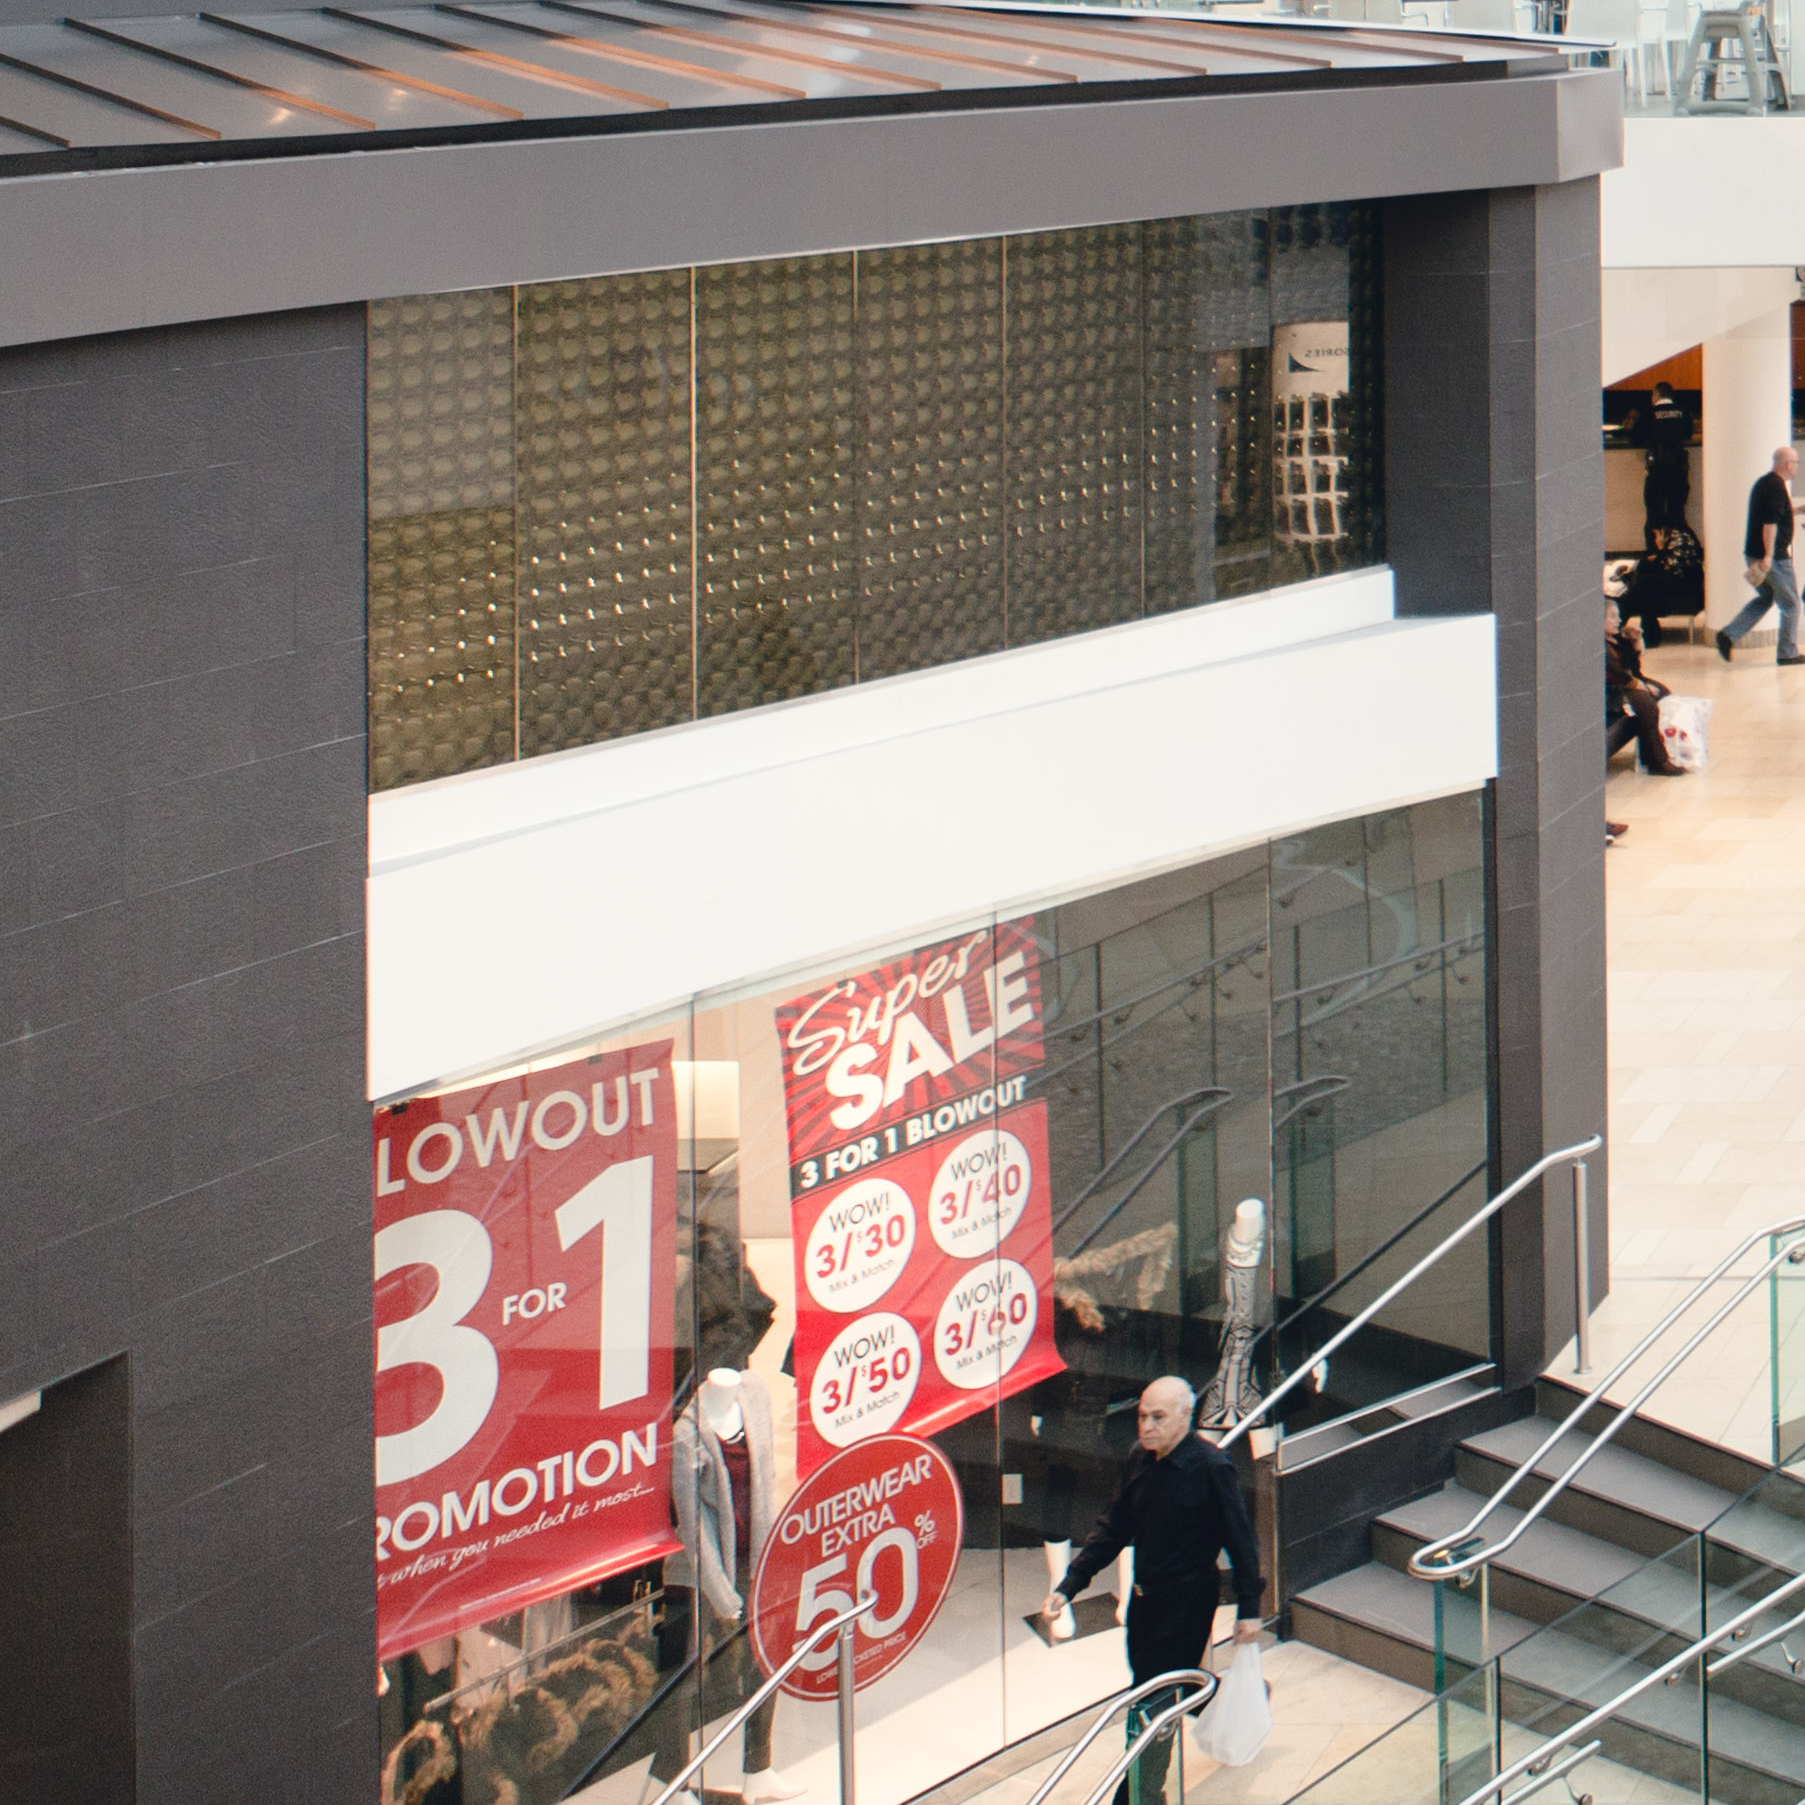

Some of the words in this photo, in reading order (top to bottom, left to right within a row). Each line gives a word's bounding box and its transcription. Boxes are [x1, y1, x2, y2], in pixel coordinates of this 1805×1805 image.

[787, 929, 989, 1076] Super
[825, 951, 1035, 1130] SALE
[800, 1160, 818, 1189] 3
[824, 1136, 879, 1180] FOR
[884, 1127, 898, 1154] 1
[906, 1075, 1028, 1146] BLOWOUT
[951, 1142, 1008, 1181] WOW!
[829, 1191, 890, 1233] WOW!
[951, 1225, 971, 1240] Mix
[980, 1206, 1012, 1228] Match
[502, 1282, 567, 1325] FOR
[554, 1154, 654, 1412] 1
[828, 1278, 849, 1293] Mix
[861, 1257, 895, 1280] Match
[955, 1270, 1012, 1313] WOW!
[833, 1324, 896, 1369] WOW!
[956, 1355, 975, 1371] Mix
[985, 1334, 1017, 1359] Match
[834, 1413, 854, 1429] Mix
[866, 1390, 900, 1415] Match
[780, 1453, 933, 1545] OUTERWEAR
[385, 1551, 448, 1586] when
[450, 1539, 489, 1572] you
[494, 1501, 570, 1549] needed
[572, 1499, 589, 1520] it
[821, 1502, 896, 1557] EXTRA
[916, 1530, 938, 1550] OFF
[792, 1526, 920, 1672] 50
